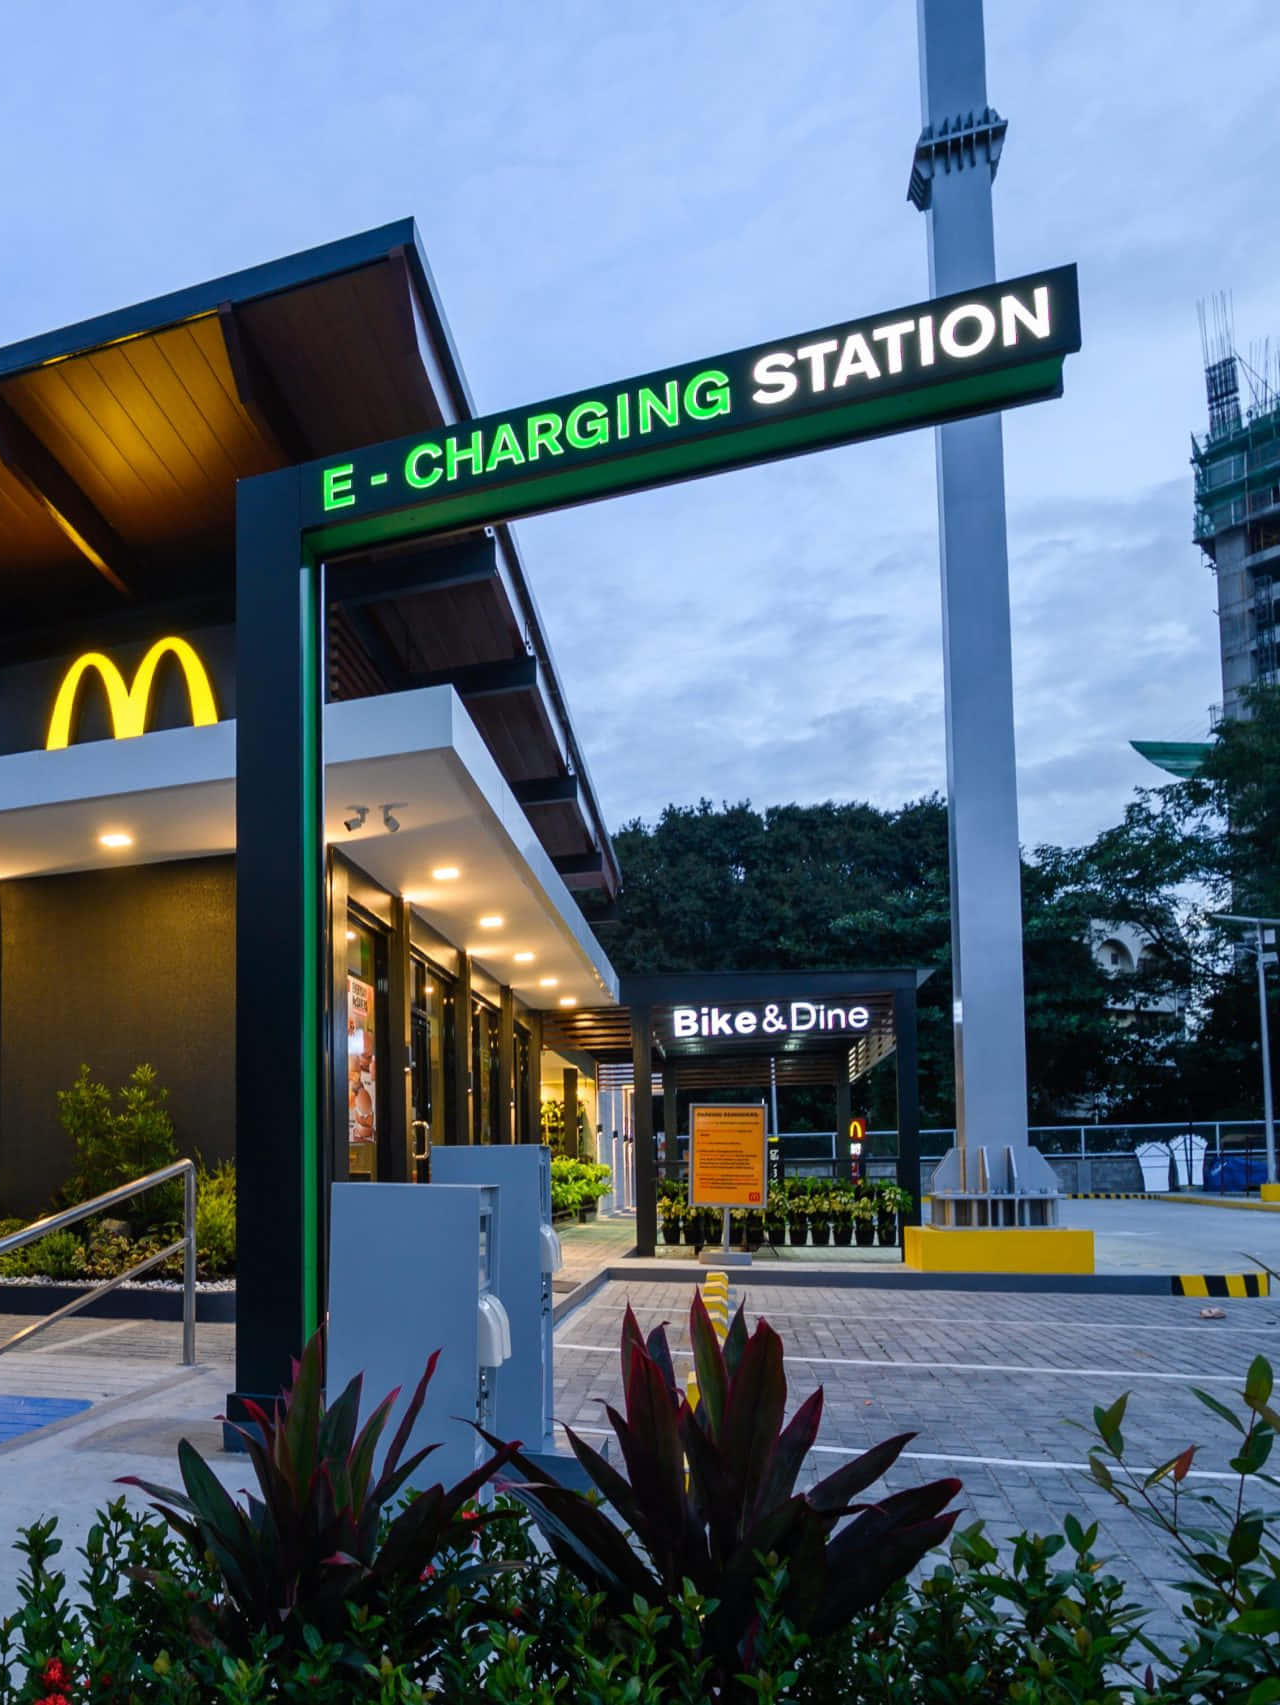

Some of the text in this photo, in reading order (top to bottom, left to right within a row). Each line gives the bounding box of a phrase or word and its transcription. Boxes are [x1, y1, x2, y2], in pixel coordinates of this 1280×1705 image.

[324, 463, 356, 511] E
[404, 369, 732, 489] CHARGING
[751, 286, 1051, 405] STATION
[673, 1002, 870, 1038] Bike & Dine
